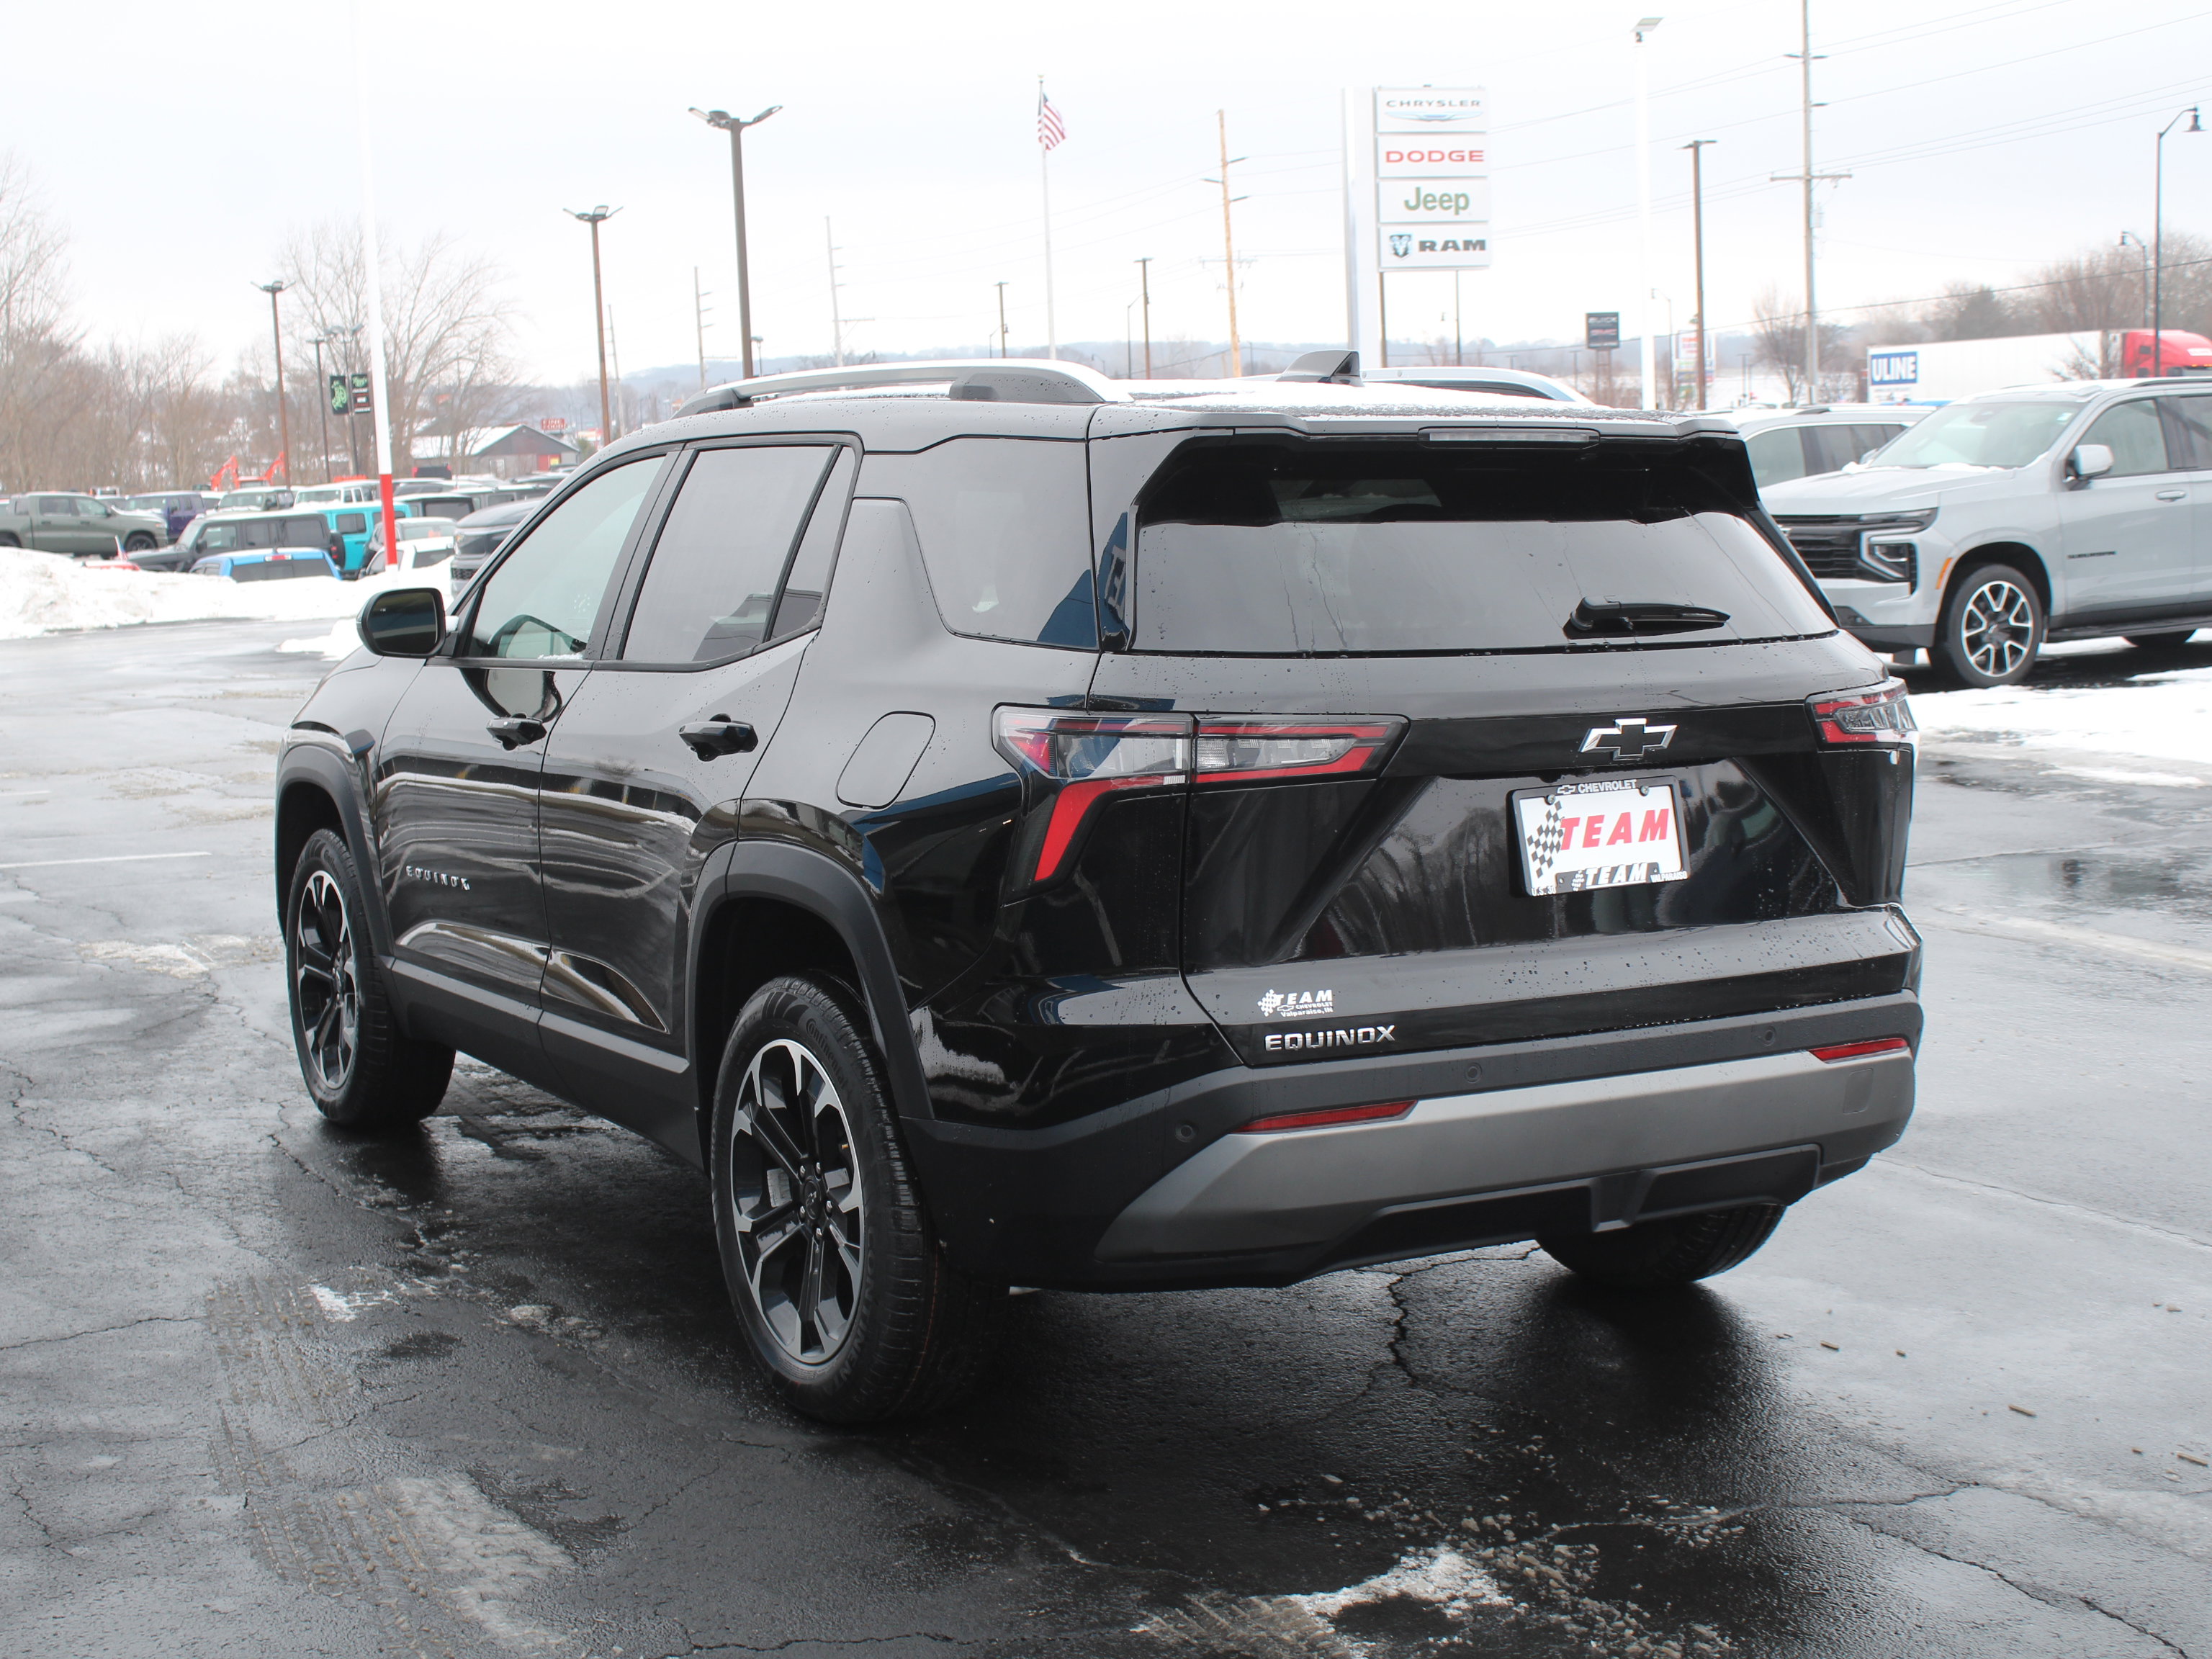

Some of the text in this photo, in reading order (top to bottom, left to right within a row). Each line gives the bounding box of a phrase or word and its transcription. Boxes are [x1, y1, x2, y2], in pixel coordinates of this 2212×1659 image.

[1385, 99, 1480, 108] CHRYSLER
[1385, 150, 1485, 163] DODGE
[1403, 186, 1470, 215] Jeep
[1419, 239, 1486, 252] RAM
[1872, 356, 1917, 382] ULINE
[1577, 779, 1638, 793] CHEVROLET
[1560, 808, 1669, 851] TEAM
[406, 866, 470, 891] EQUINOX
[1586, 863, 1647, 887] TEAM
[1650, 870, 1689, 884] VALPARAISO
[1531, 885, 1557, 897] U.S. 30
[1274, 989, 1333, 1007] TEAM
[1265, 1025, 1395, 1051] EQUINOX
[806, 1017, 849, 1089] Continental
[814, 1226, 876, 1399] CONTINENTA
